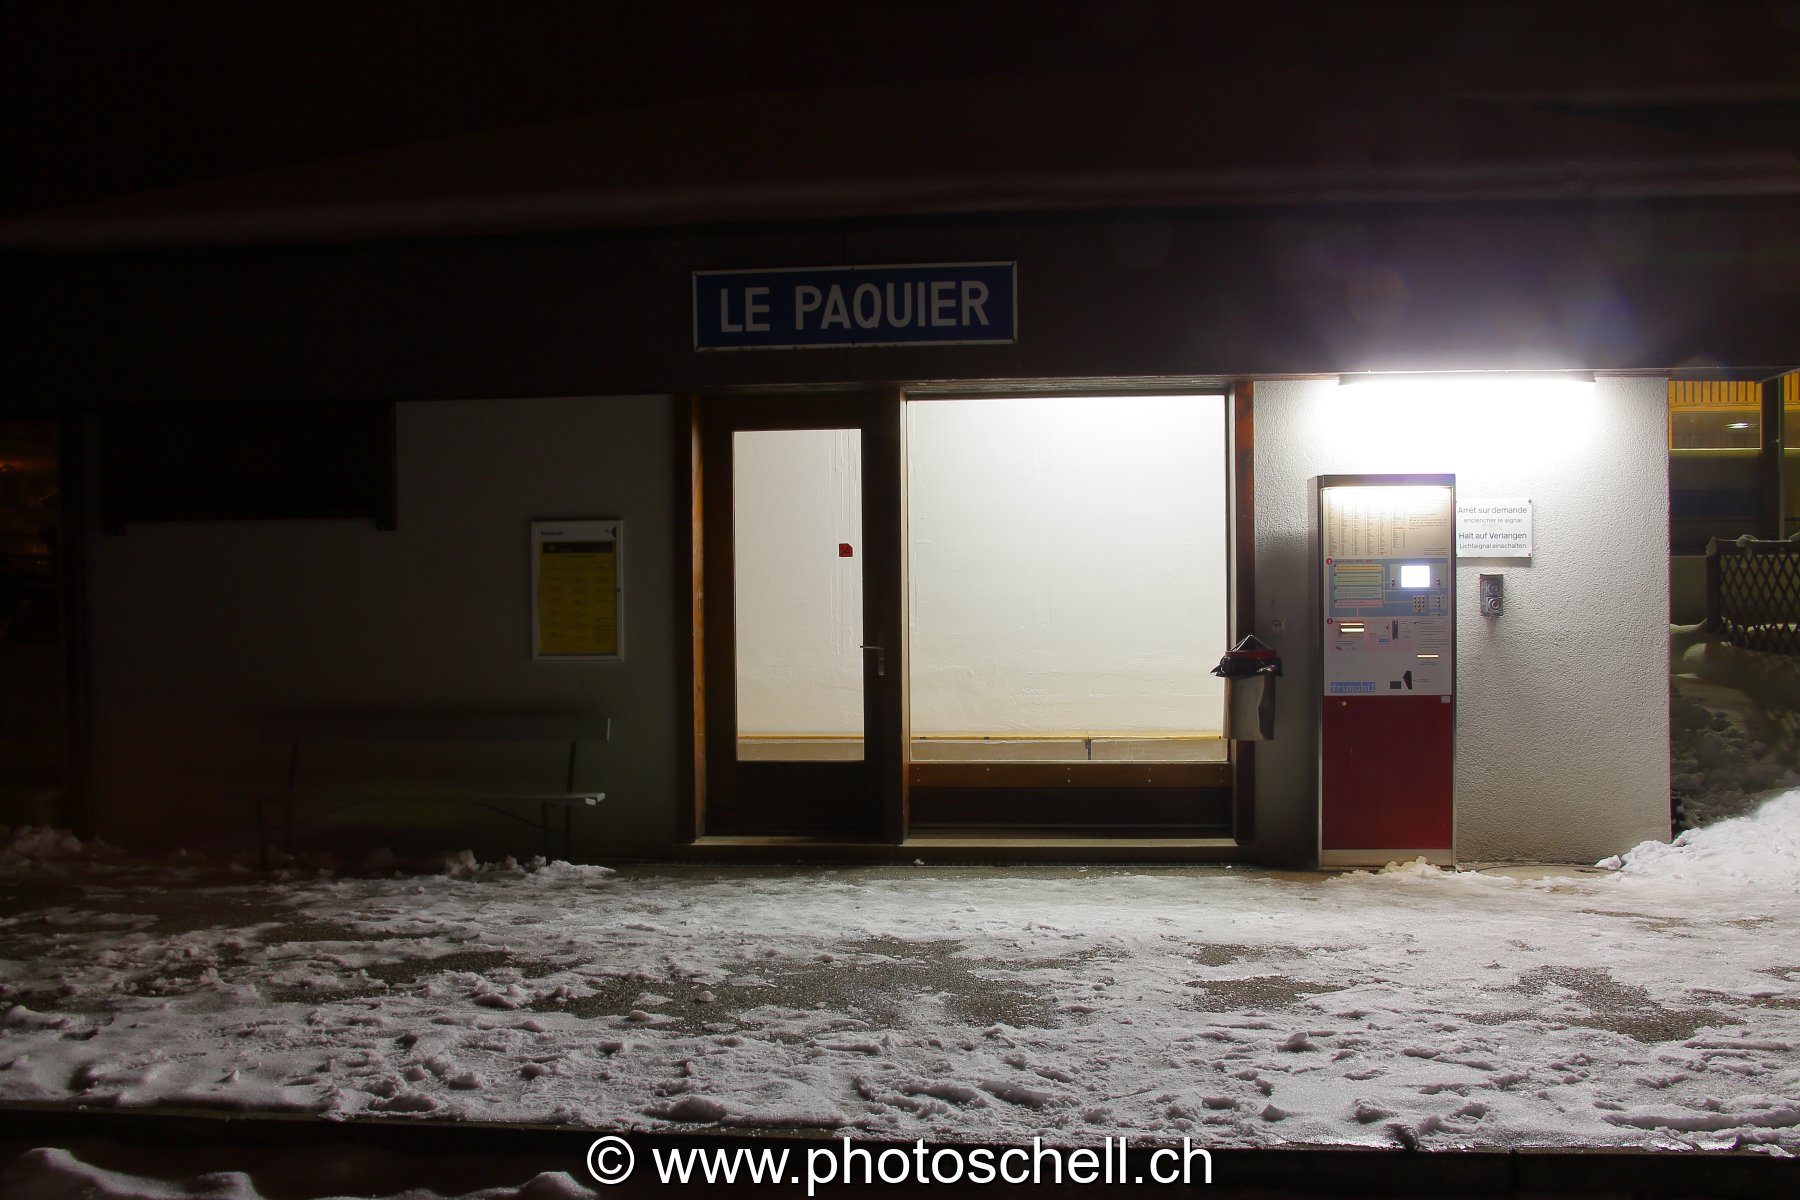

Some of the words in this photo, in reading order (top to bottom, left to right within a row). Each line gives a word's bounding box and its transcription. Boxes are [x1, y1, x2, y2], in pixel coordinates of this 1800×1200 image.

[720, 287, 770, 333] LE
[794, 280, 990, 331] PAQUIER
[1488, 532, 1527, 541] Verlangen
